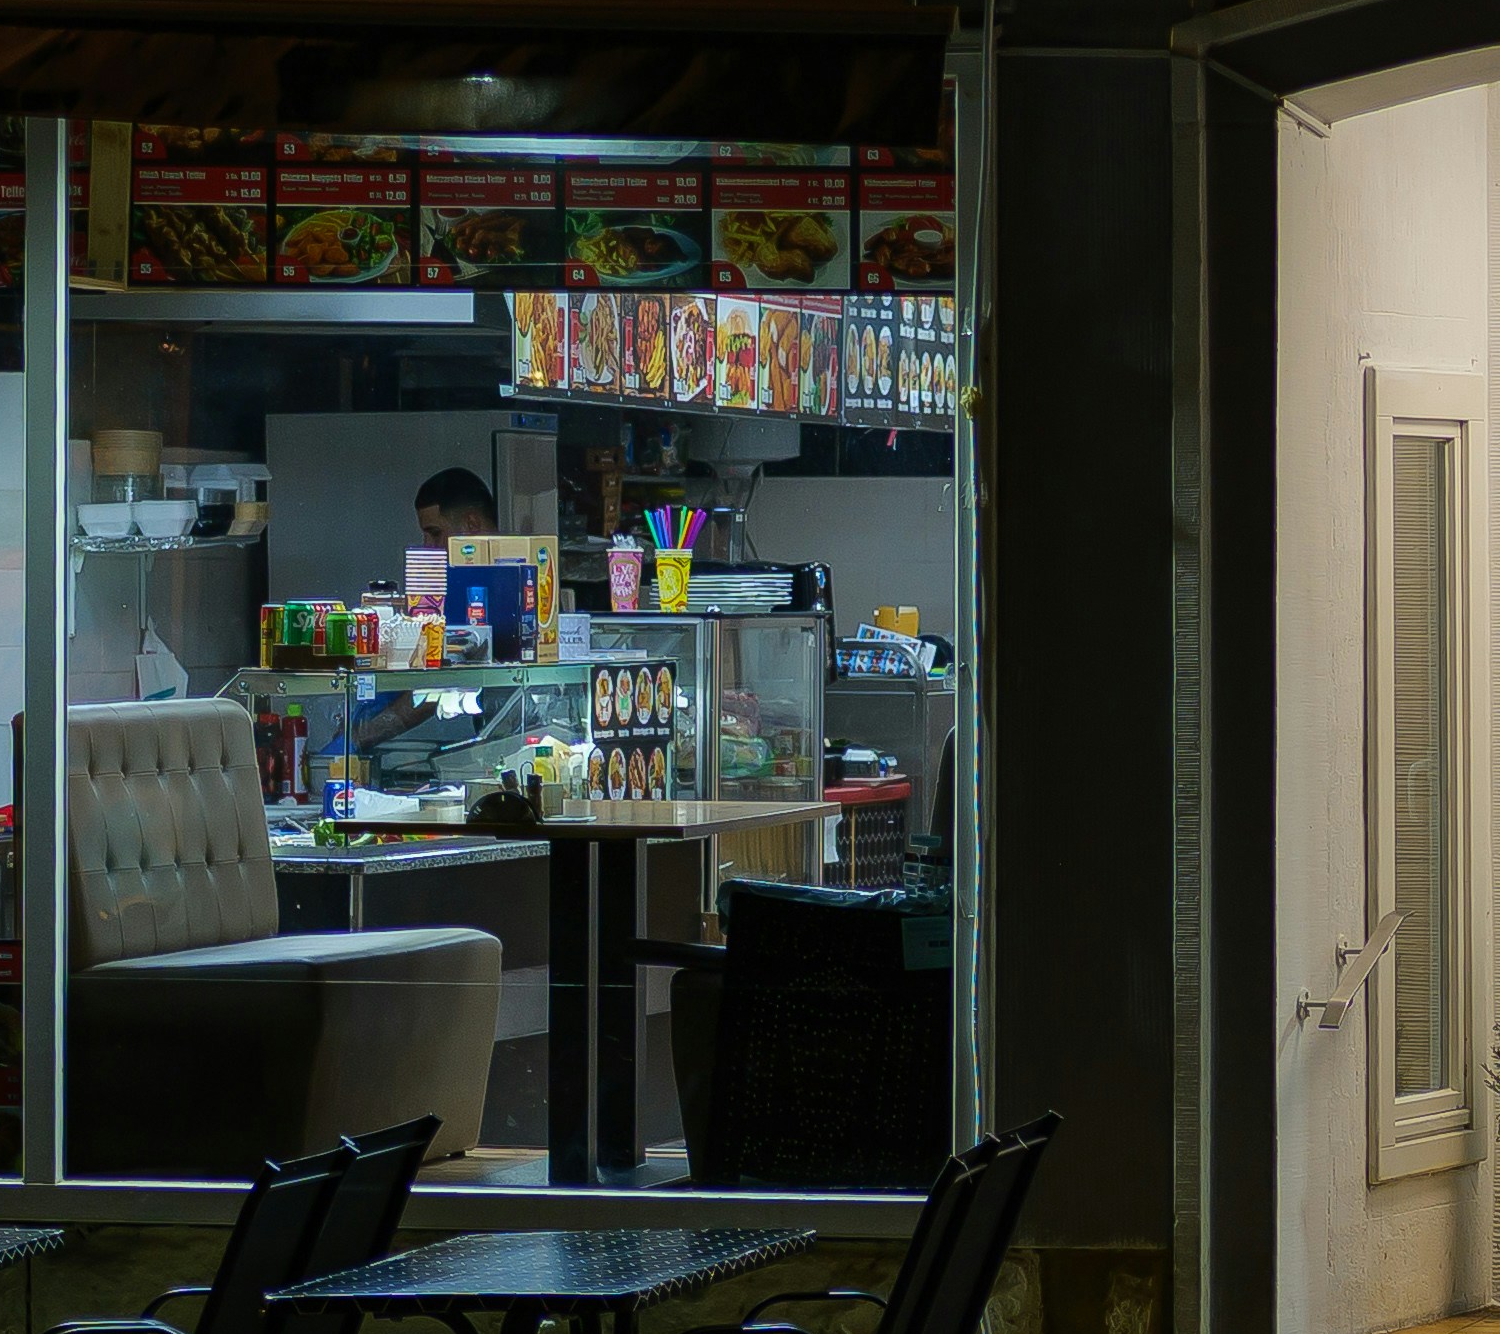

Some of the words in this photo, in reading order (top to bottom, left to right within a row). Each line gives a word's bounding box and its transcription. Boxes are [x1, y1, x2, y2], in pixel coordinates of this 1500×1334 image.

[427, 268, 439, 278] 57
[572, 270, 585, 280] 64
[720, 271, 732, 282] 65
